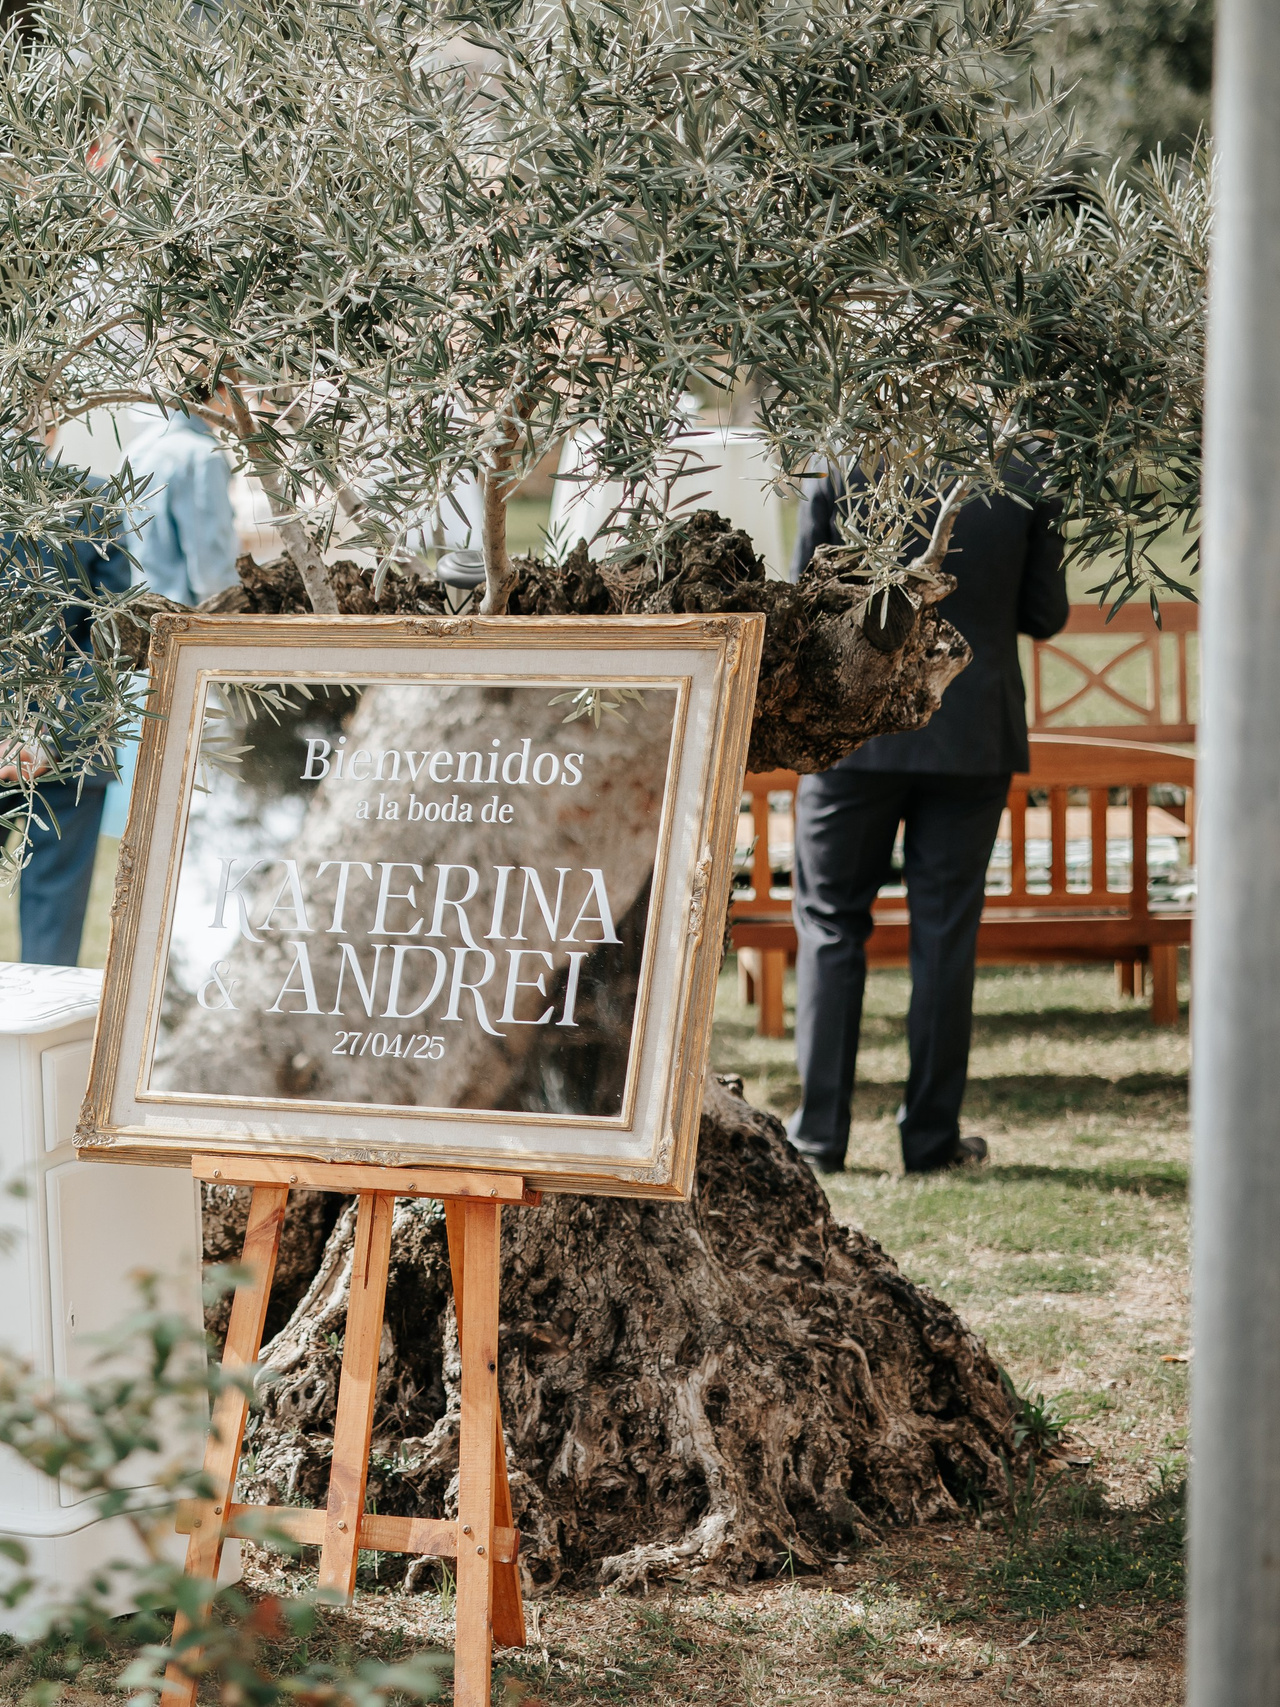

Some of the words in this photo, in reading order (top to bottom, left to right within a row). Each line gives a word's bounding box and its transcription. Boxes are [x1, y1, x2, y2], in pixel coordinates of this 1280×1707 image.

[300, 736, 584, 787] Bienvenidos
[355, 801, 370, 820] a
[376, 793, 399, 821] la
[407, 794, 474, 823] boda
[481, 796, 514, 824] de
[207, 856, 624, 949] KATERINA
[196, 959, 240, 1011] &
[265, 940, 590, 1037] ANDREI
[331, 1030, 446, 1060] 27/04/25
